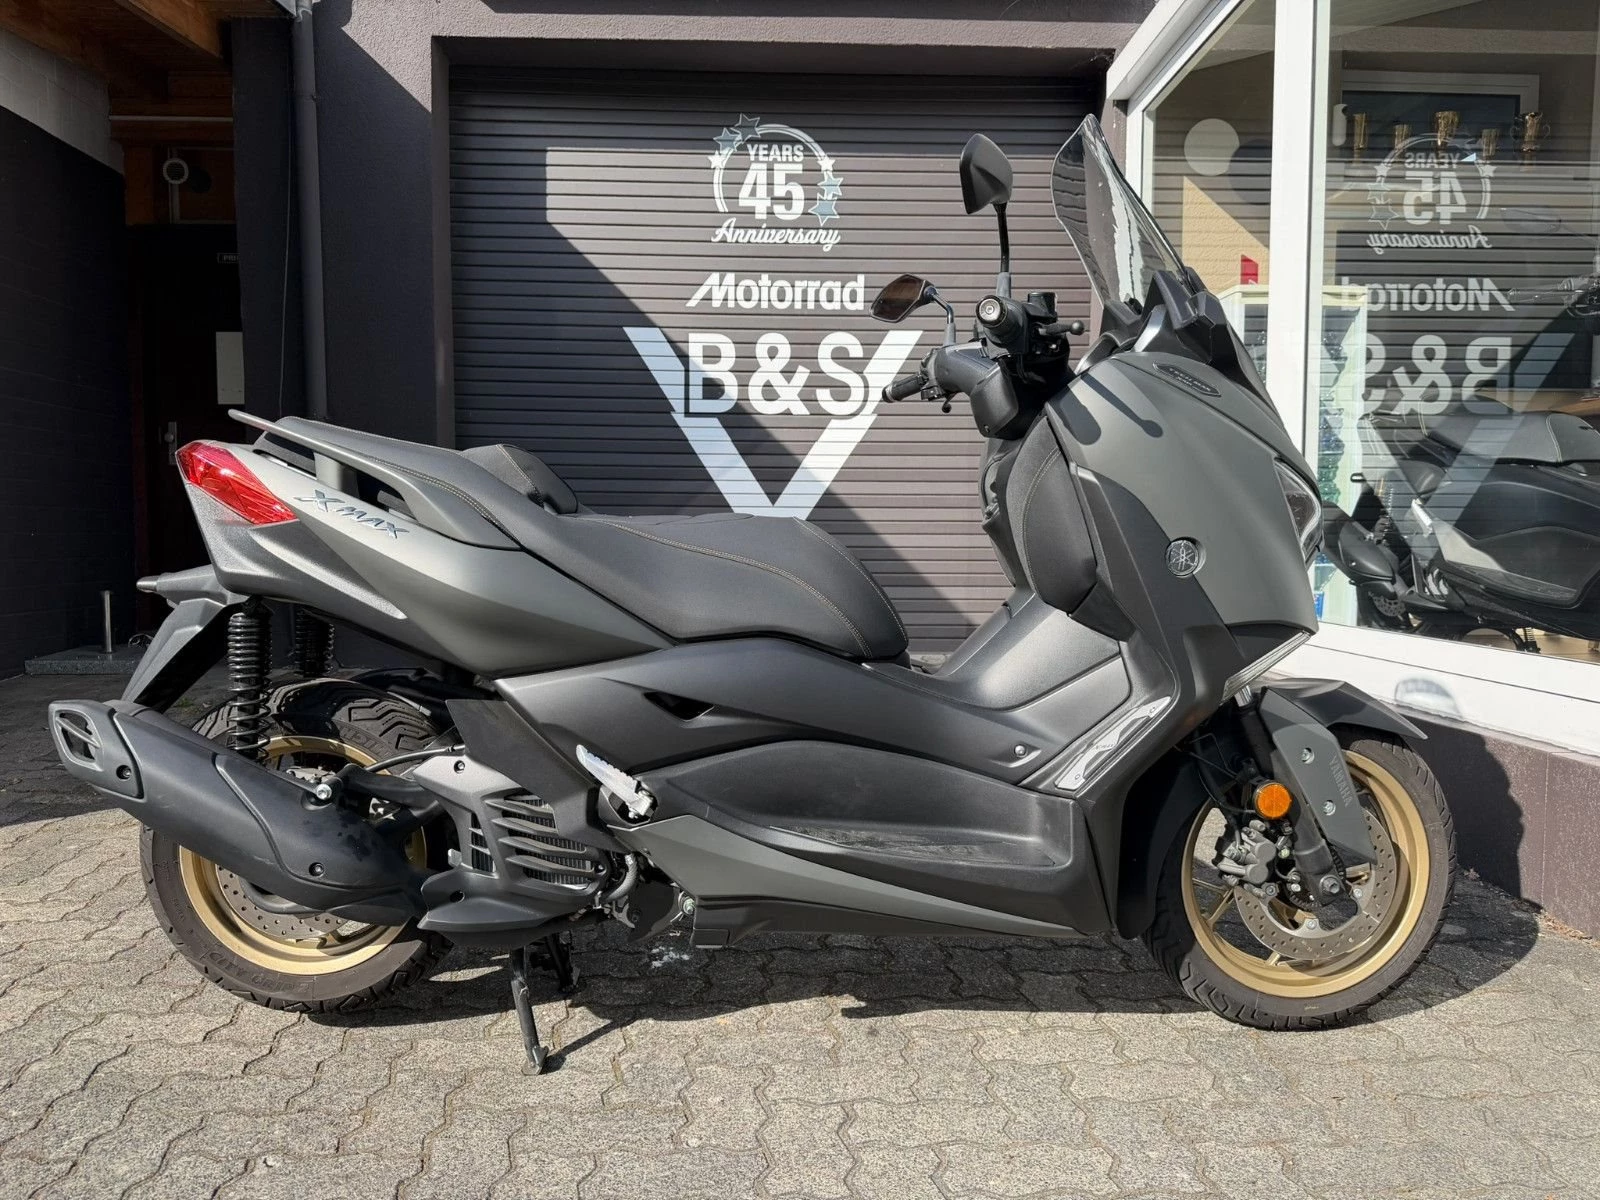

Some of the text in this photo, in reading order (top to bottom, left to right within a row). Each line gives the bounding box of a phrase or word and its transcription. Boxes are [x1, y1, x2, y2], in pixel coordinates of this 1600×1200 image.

[746, 143, 804, 162] YEARS
[738, 162, 804, 220] 45
[711, 217, 841, 251] Anniversary
[685, 272, 865, 311] Motorrad
[688, 331, 866, 416] B&S
